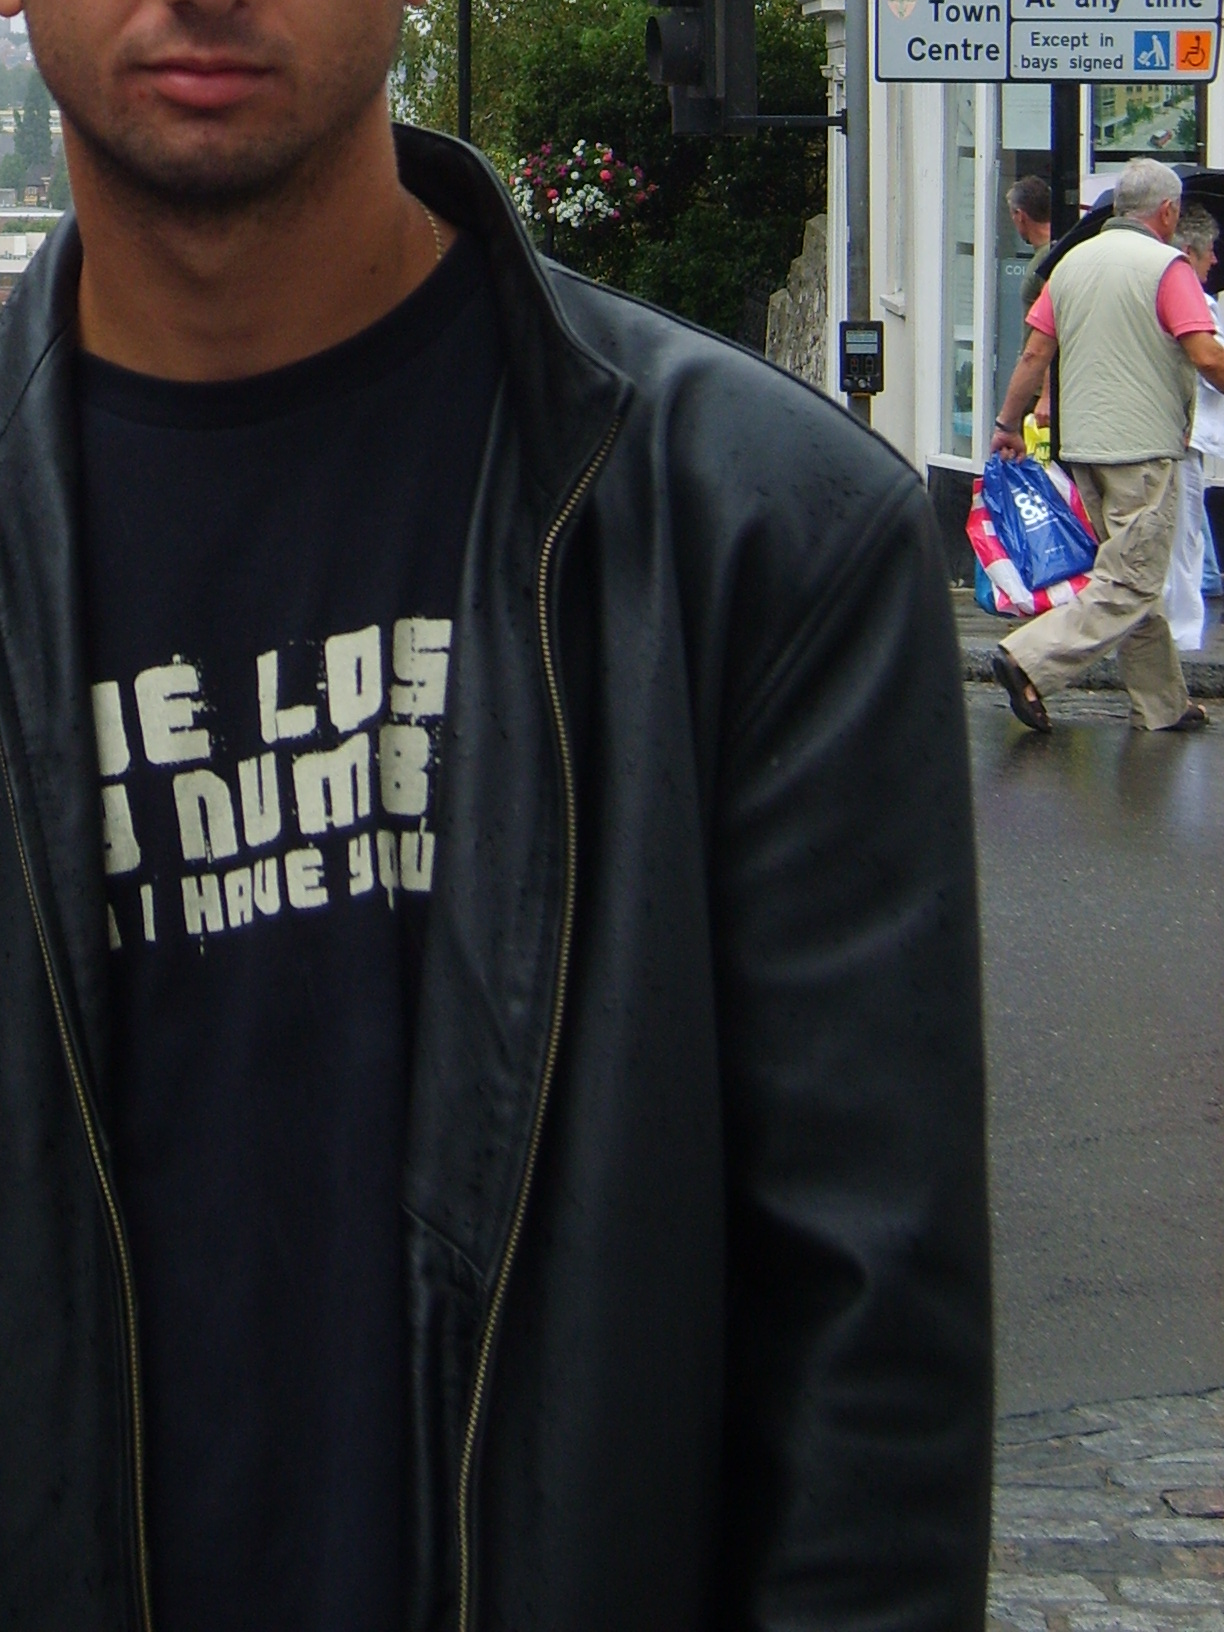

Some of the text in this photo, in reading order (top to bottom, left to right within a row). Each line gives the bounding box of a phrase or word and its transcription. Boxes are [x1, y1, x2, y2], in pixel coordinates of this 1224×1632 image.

[907, 37, 1000, 61] Centre
[1030, 31, 1114, 50] Except in
[1021, 54, 1124, 75] bays signed
[181, 848, 329, 935] HAVE
